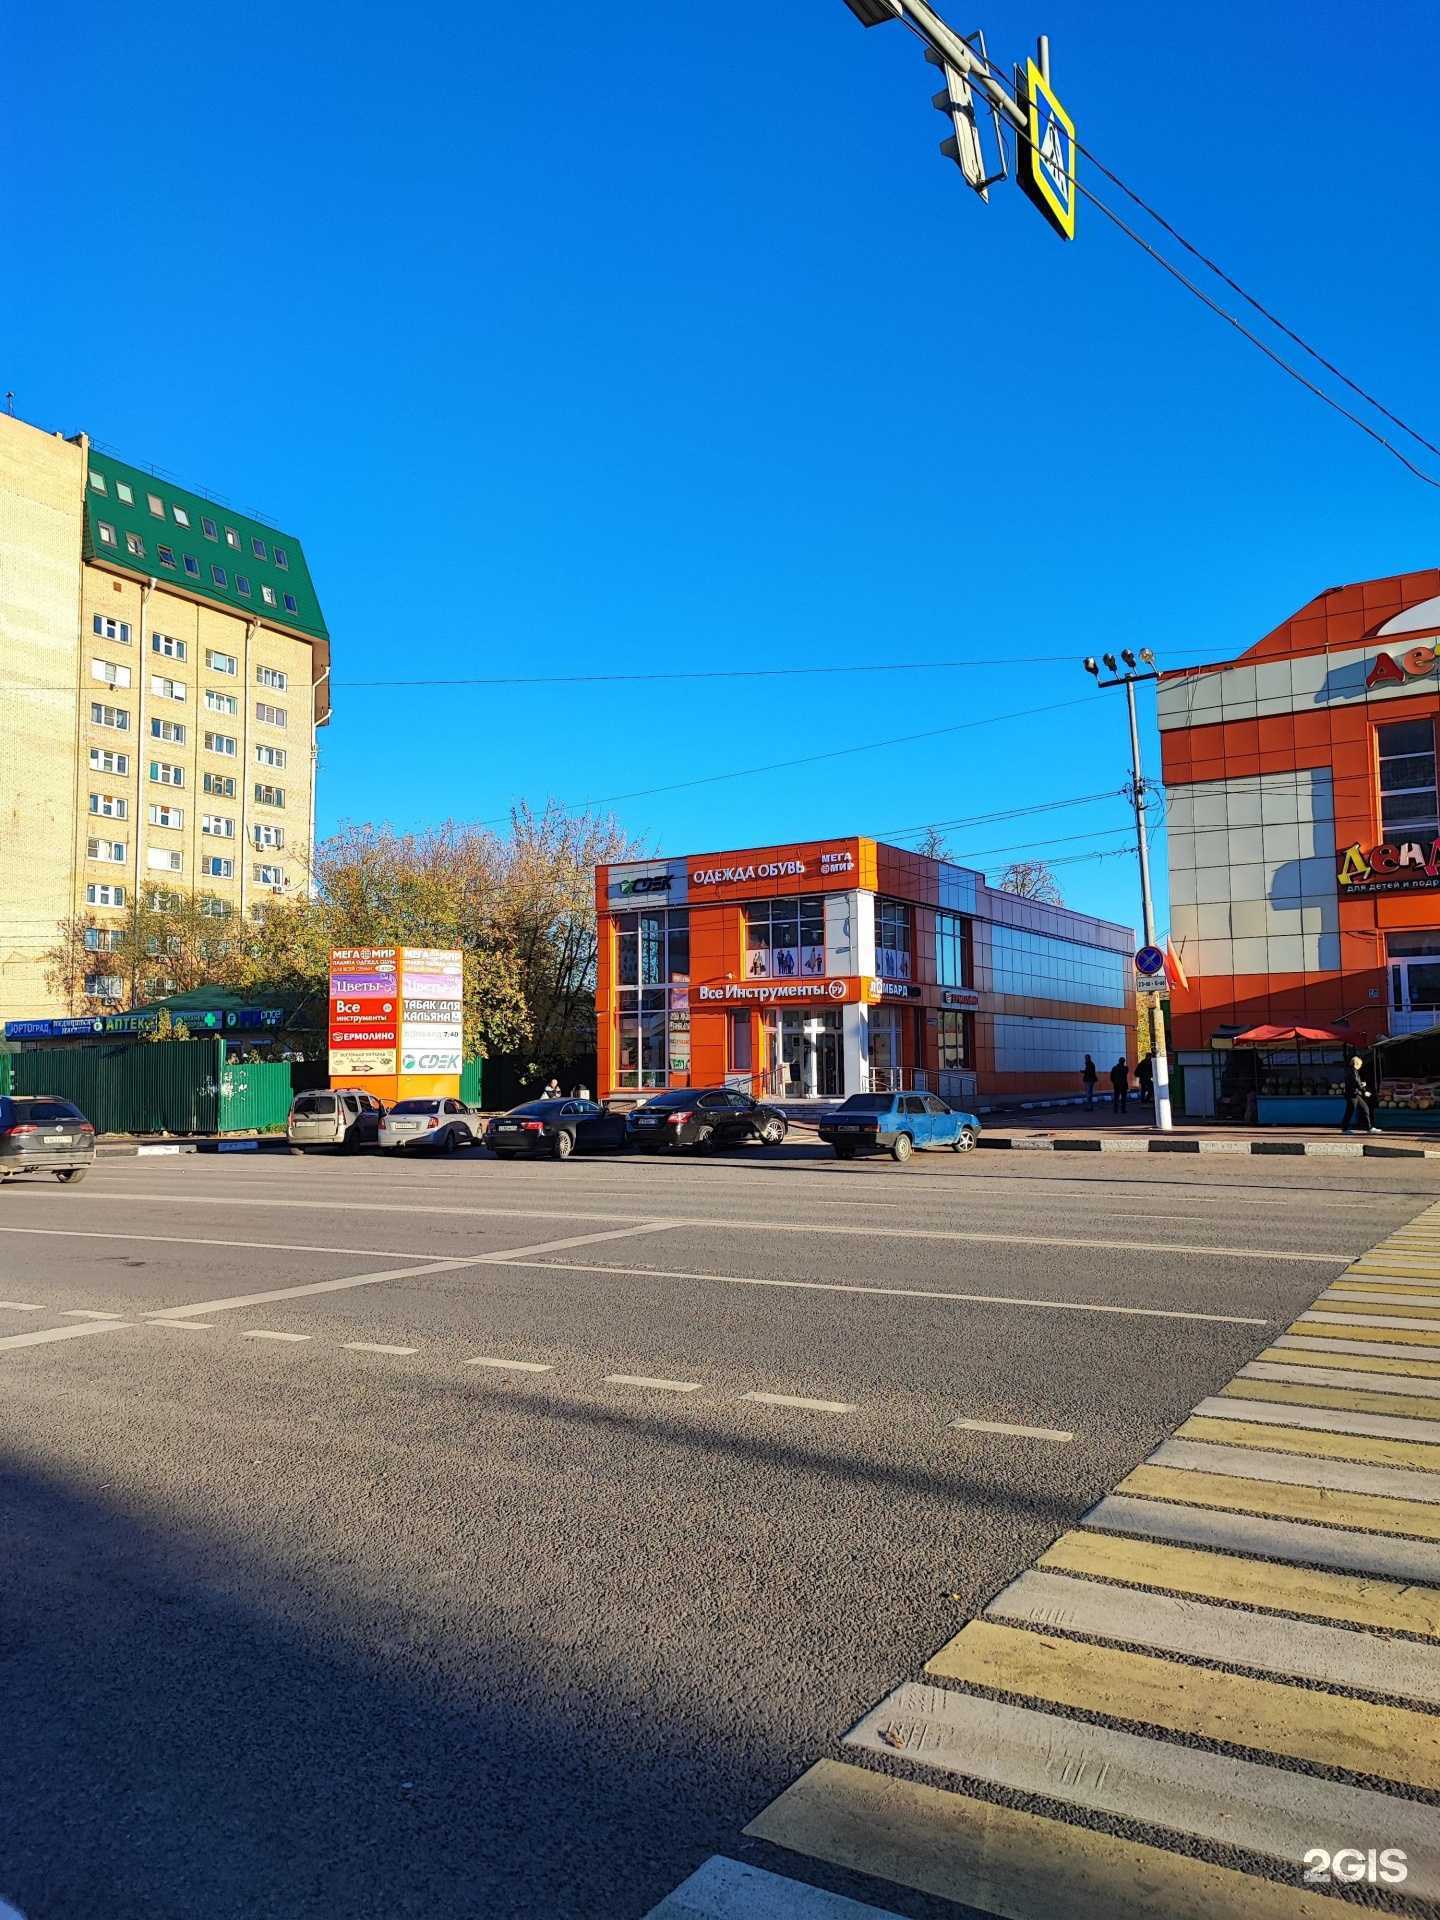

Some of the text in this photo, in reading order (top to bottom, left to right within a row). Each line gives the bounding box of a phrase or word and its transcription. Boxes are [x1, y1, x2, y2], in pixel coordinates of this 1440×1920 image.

[821, 852, 852, 863] МЕГА
[693, 858, 806, 884] ОДЕЖДА ОБУВЬ
[832, 862, 855, 872] МИР
[1369, 881, 1399, 890] детей
[333, 949, 396, 959] МЕГА МИР
[337, 981, 380, 992] Цветы
[699, 985, 724, 999] Все
[870, 981, 908, 997] ЛОМБАРД
[336, 1000, 360, 1013] Все
[404, 1000, 437, 1010] ТАБАК
[439, 1001, 460, 1011] ДЛЯ
[336, 1015, 387, 1023] инструменты
[404, 1011, 451, 1022] КАЛЬЯНА
[344, 1032, 394, 1040] ЕРМОЛИНО
[419, 1054, 460, 1069] CDEK
